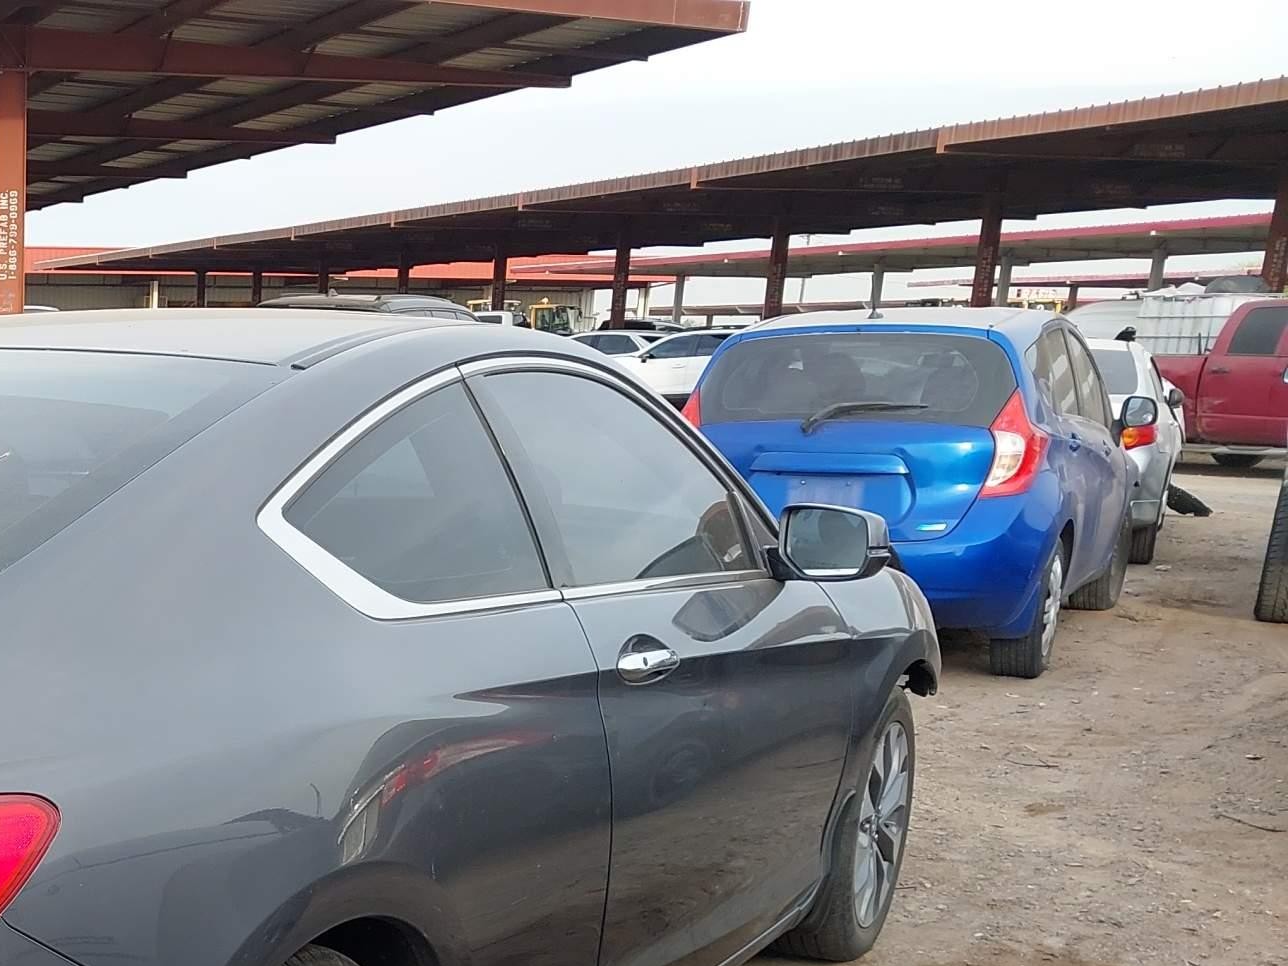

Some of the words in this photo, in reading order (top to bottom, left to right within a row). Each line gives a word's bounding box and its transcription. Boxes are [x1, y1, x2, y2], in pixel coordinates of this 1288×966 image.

[0, 189, 9, 210] INC.
[0, 214, 9, 255] PREFAB
[0, 262, 9, 281] U.S.
